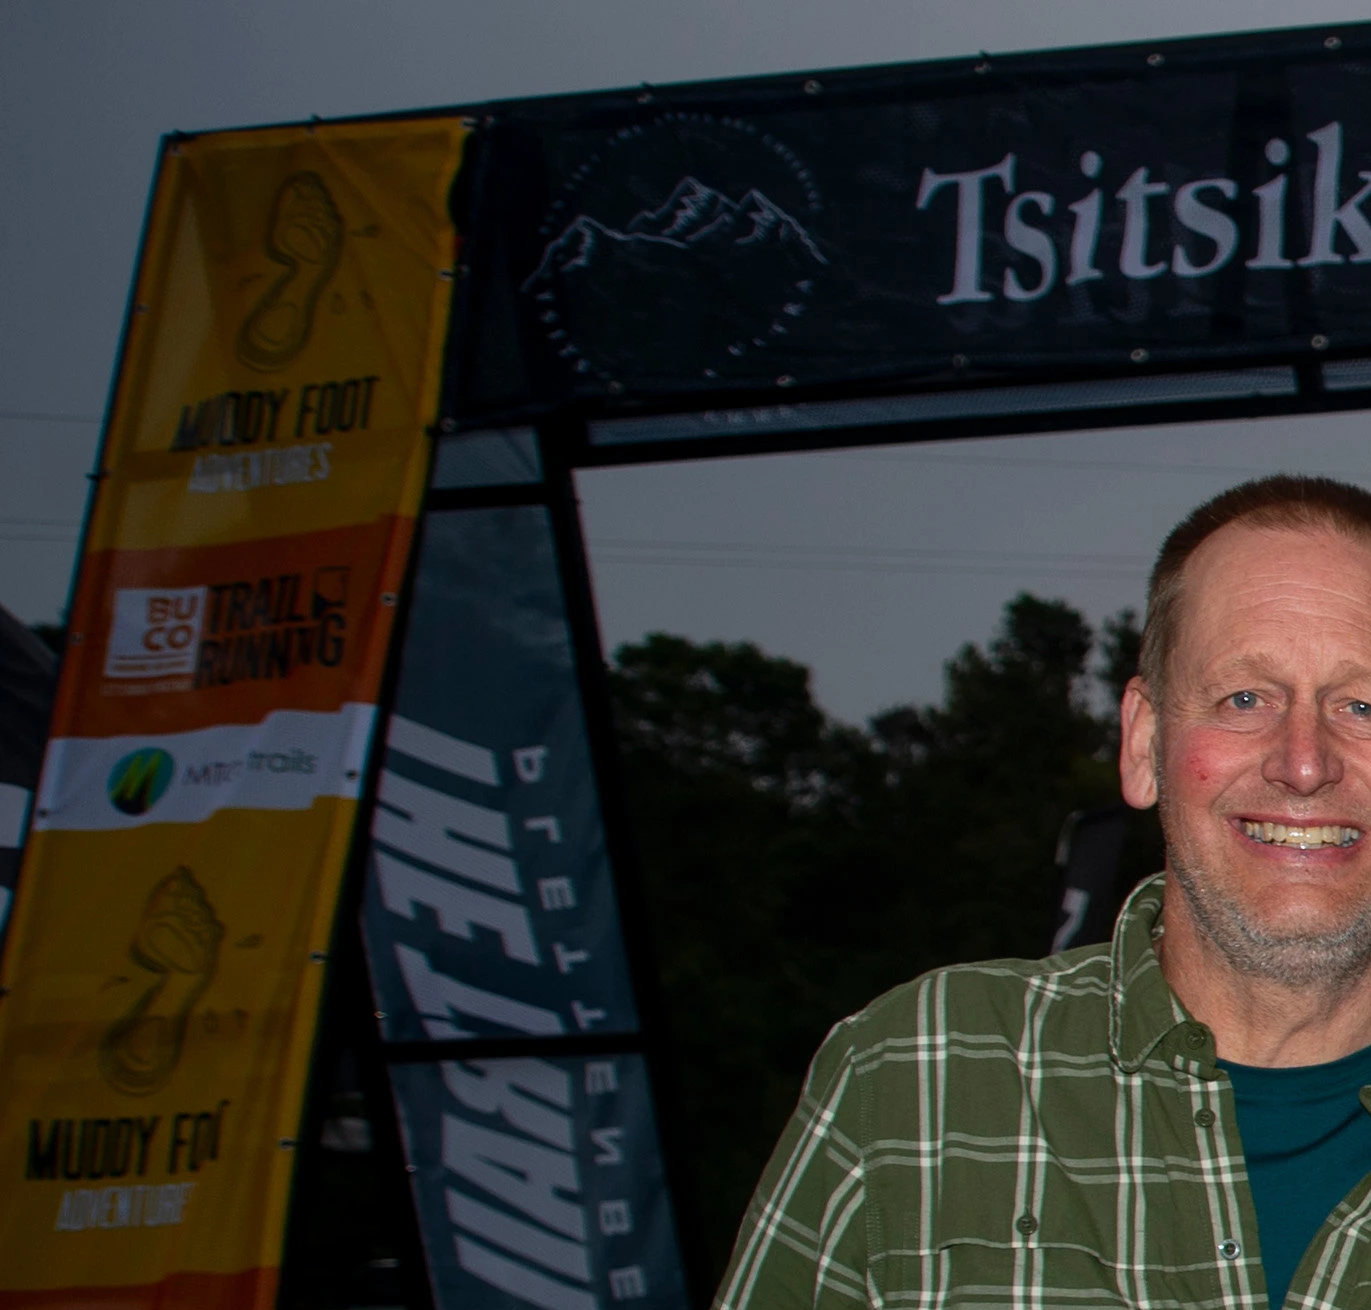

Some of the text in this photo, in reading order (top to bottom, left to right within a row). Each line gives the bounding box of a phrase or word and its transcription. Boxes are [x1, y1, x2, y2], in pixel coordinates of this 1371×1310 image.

[295, 375, 381, 438] FOOT
[207, 573, 304, 634] TRAIL
[26, 1116, 160, 1180] MUDDY
